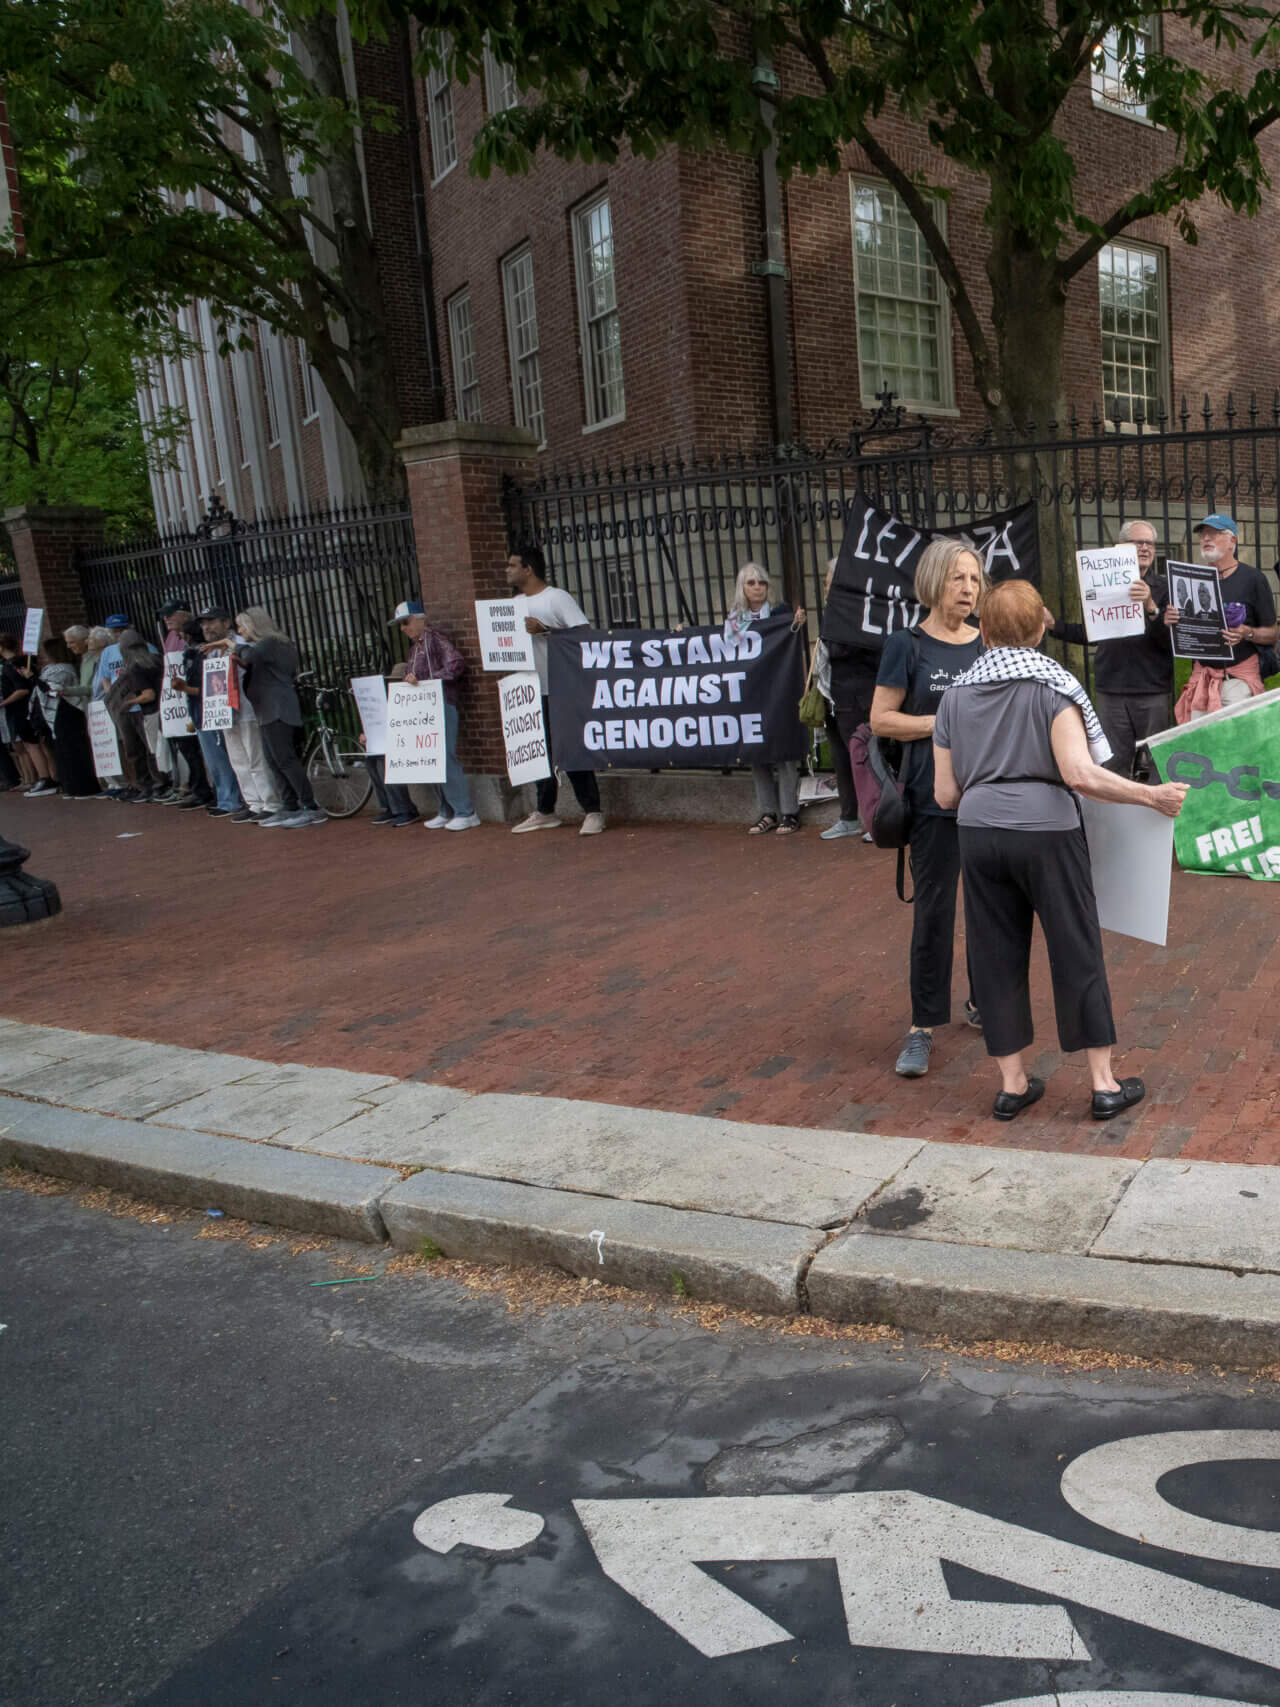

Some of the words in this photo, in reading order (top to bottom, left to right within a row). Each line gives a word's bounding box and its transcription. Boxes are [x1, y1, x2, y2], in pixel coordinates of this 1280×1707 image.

[854, 507, 922, 567] LET
[1080, 556, 1136, 571] PALESTINIAN
[1091, 570, 1132, 587] LIVES
[489, 605, 515, 617] OPPOSING
[861, 577, 921, 636] LIV
[1091, 603, 1142, 623] MATTER
[491, 620, 516, 632] GENOCIDE
[489, 651, 527, 663] ANTI-SEMITISM
[579, 640, 634, 669] WE
[640, 630, 763, 668] STAND
[394, 691, 437, 708] Opposing
[503, 684, 536, 712] DEFEND
[592, 671, 747, 710] AGAINST
[164, 706, 187, 720] STUD
[389, 711, 435, 728] Genocide
[504, 709, 541, 739] STUDENT
[583, 713, 764, 751] GENOCIDE
[396, 734, 406, 748] is
[415, 732, 439, 749] NOT
[506, 739, 546, 769] PROTESTERS
[1195, 815, 1264, 864] FRE
